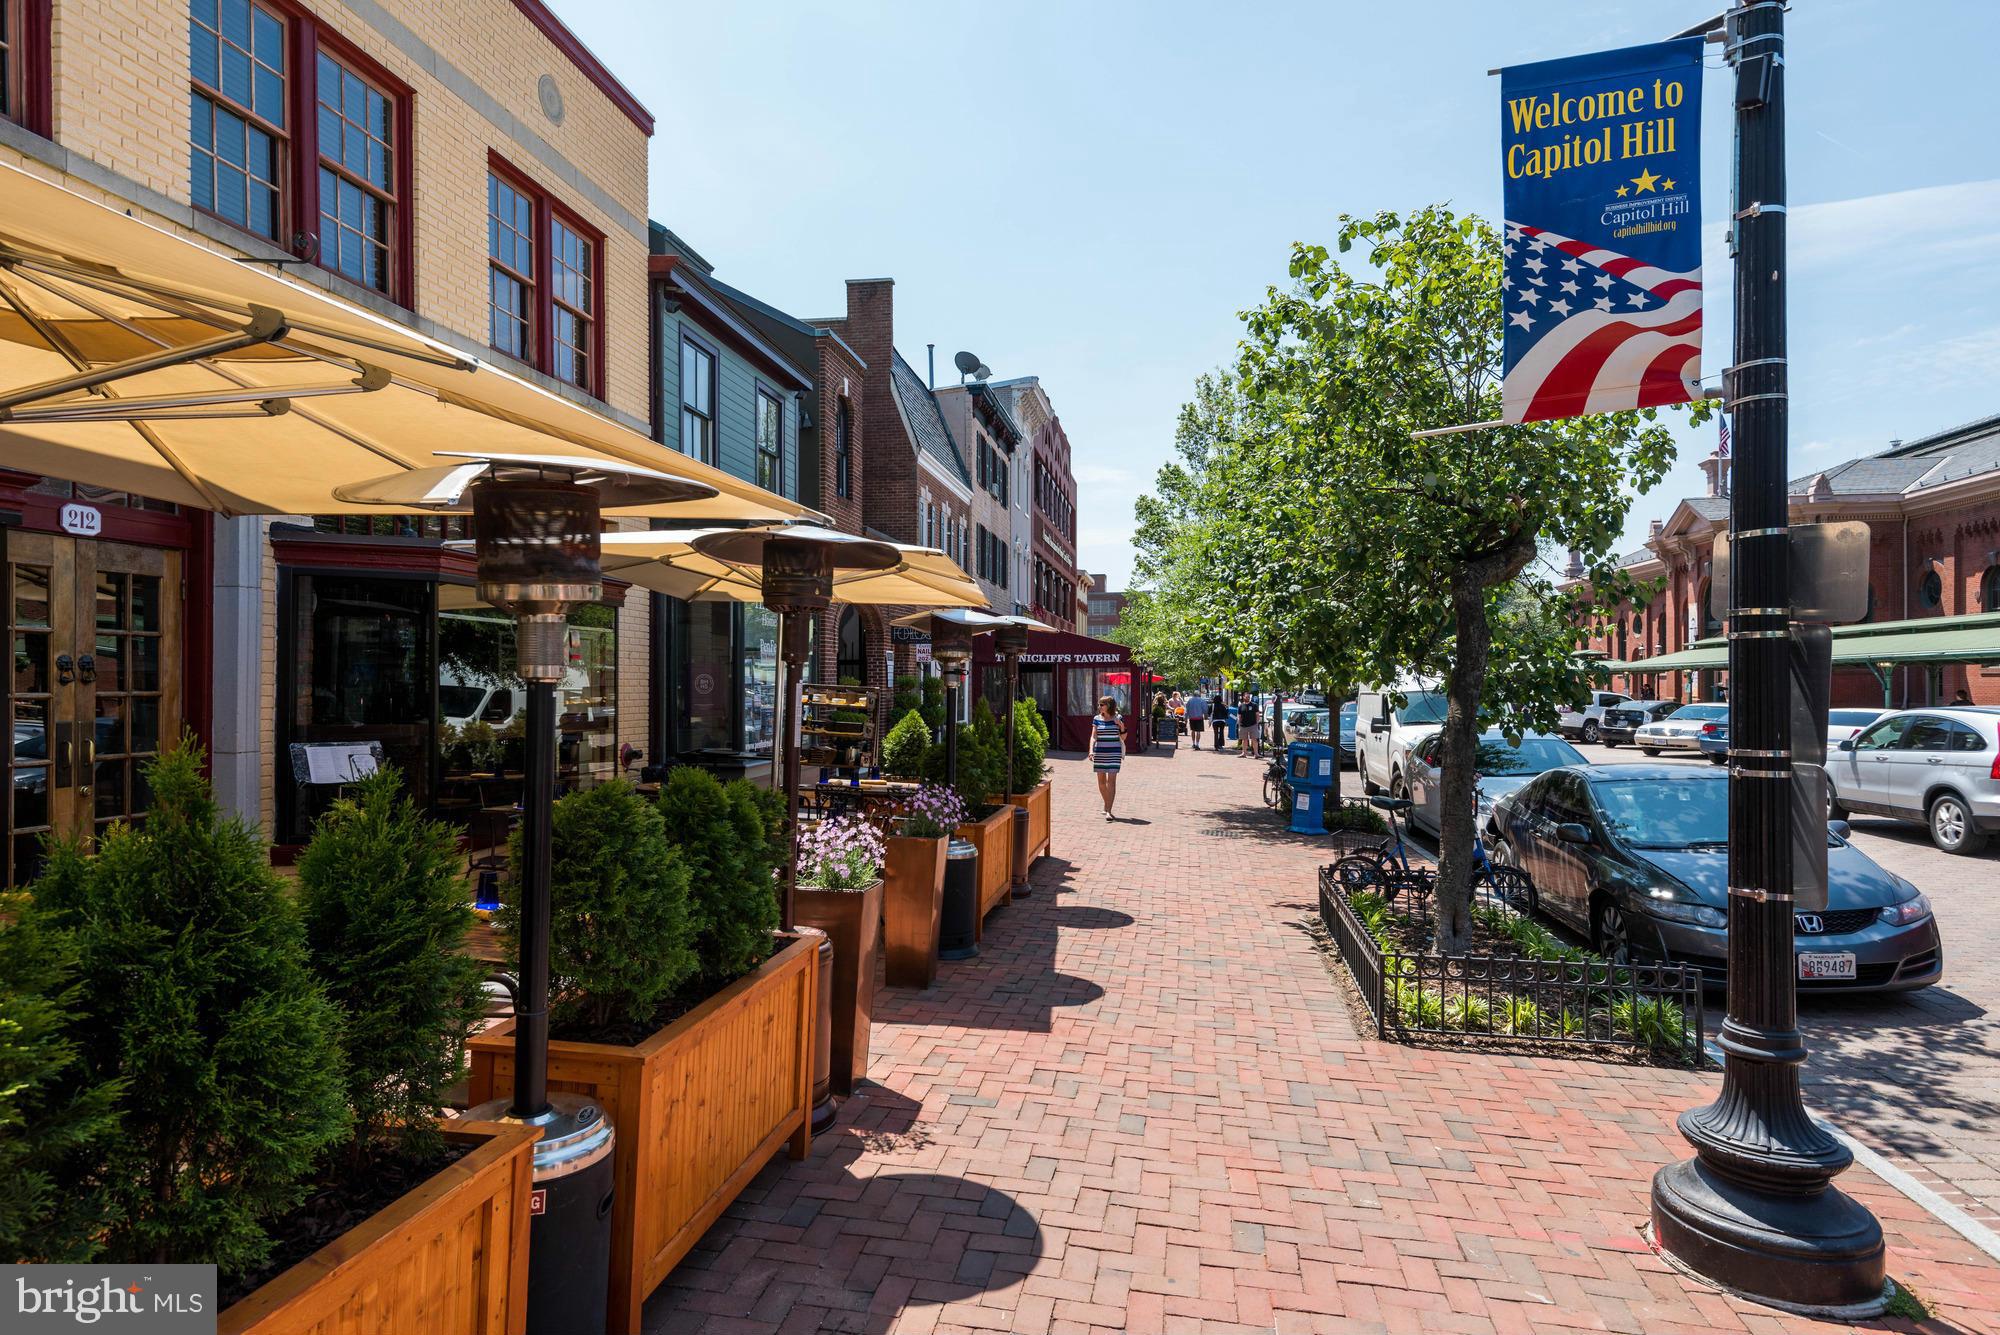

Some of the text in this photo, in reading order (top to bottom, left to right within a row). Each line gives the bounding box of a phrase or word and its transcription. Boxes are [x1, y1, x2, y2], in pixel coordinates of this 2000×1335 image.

[1507, 78, 1683, 134] Welcome to
[1507, 117, 1676, 180] Capitol Hill
[1601, 200, 1689, 226] Capitol Hill
[1613, 219, 1677, 239] capitolhillbid.org
[68, 509, 95, 530] 212
[1074, 654, 1120, 663] TAVERN
